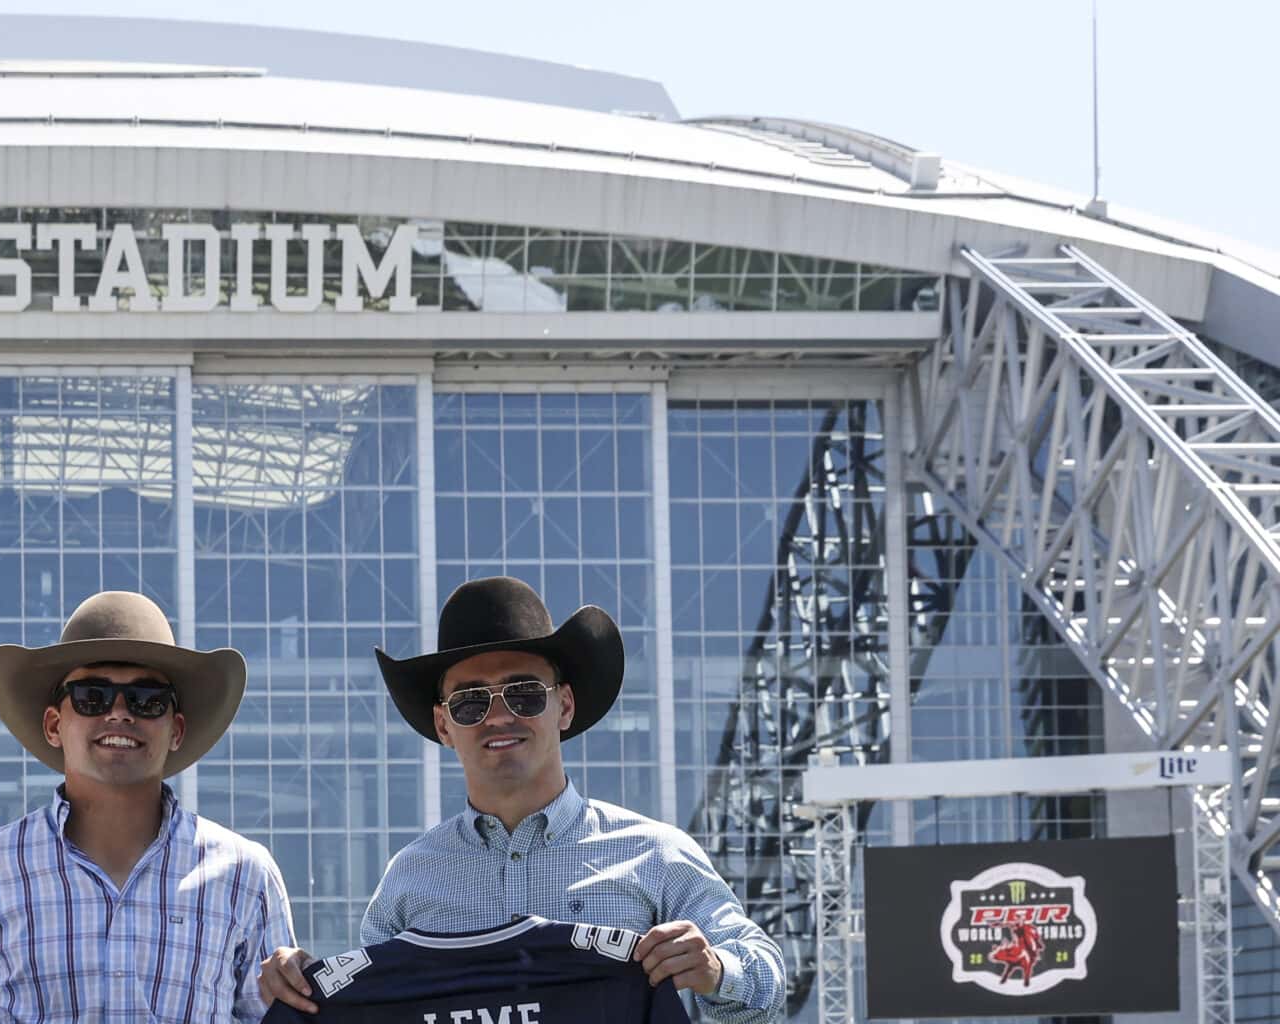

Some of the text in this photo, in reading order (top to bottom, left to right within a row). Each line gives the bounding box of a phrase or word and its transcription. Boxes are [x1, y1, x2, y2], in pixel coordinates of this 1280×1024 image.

[1160, 757, 1197, 779] Lite
[971, 905, 1071, 925] PBR
[958, 925, 1083, 942] WORLD FINALS
